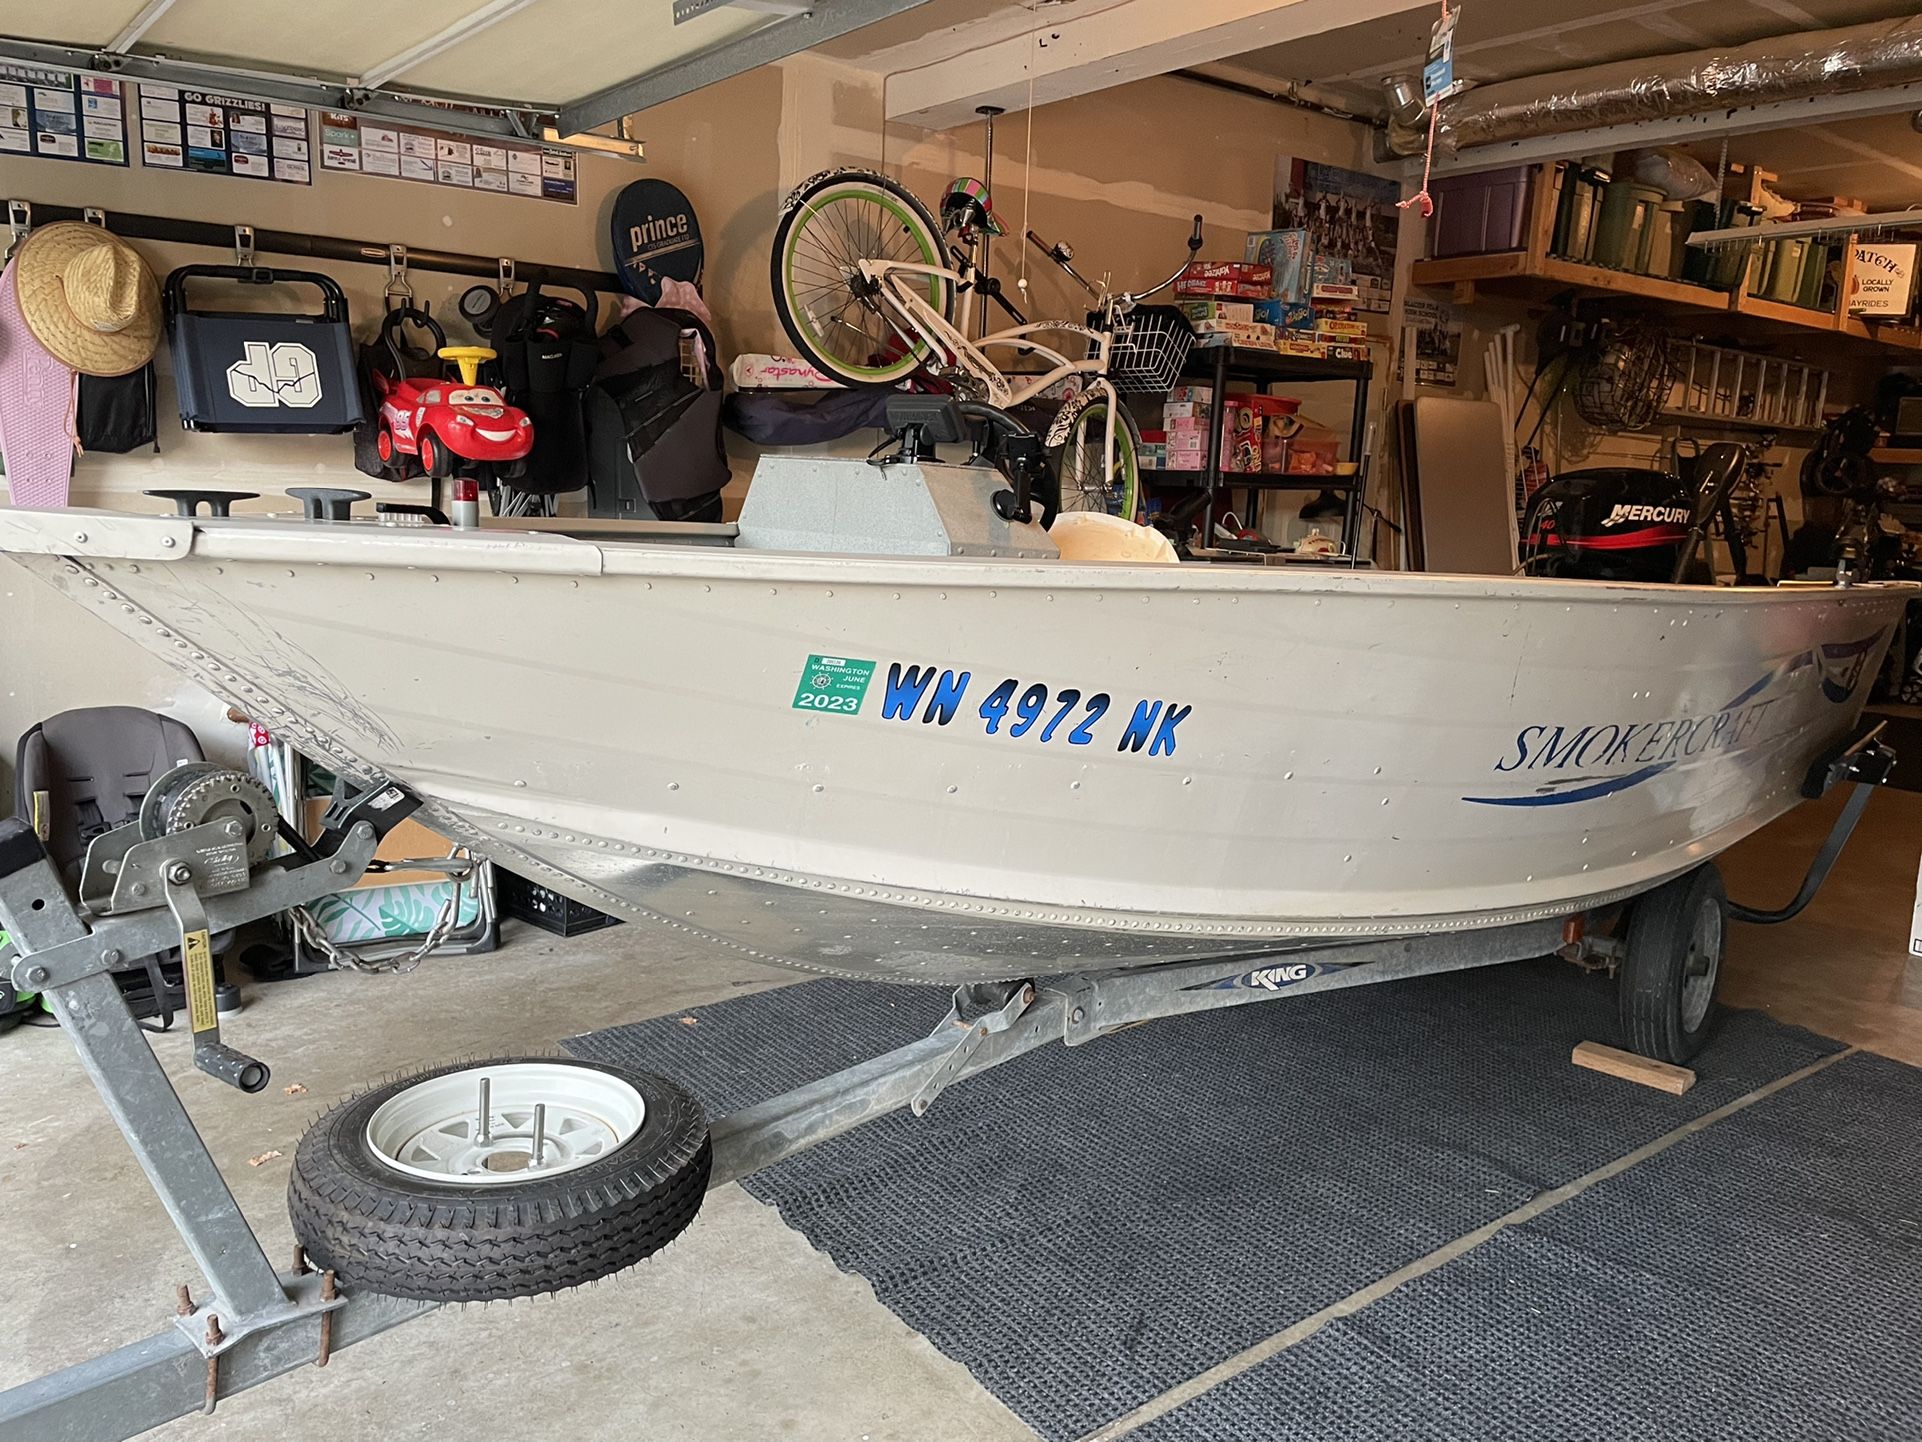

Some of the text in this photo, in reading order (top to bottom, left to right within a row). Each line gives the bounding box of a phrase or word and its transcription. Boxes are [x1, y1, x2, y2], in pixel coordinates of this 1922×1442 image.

[184, 91, 266, 112] GO GRIZZLIES!
[630, 214, 688, 252] prince
[1863, 285, 1890, 293] GROWN
[1335, 348, 1353, 359] Clue
[1602, 504, 1690, 527] MERCURY
[811, 664, 870, 676] WASHINGTON
[843, 675, 866, 684] JUNE
[798, 692, 859, 711] 2023
[881, 662, 1192, 757] WN 4972 NK
[1493, 700, 1776, 772] SMOKERCRAFT
[1251, 964, 1307, 991] KING
